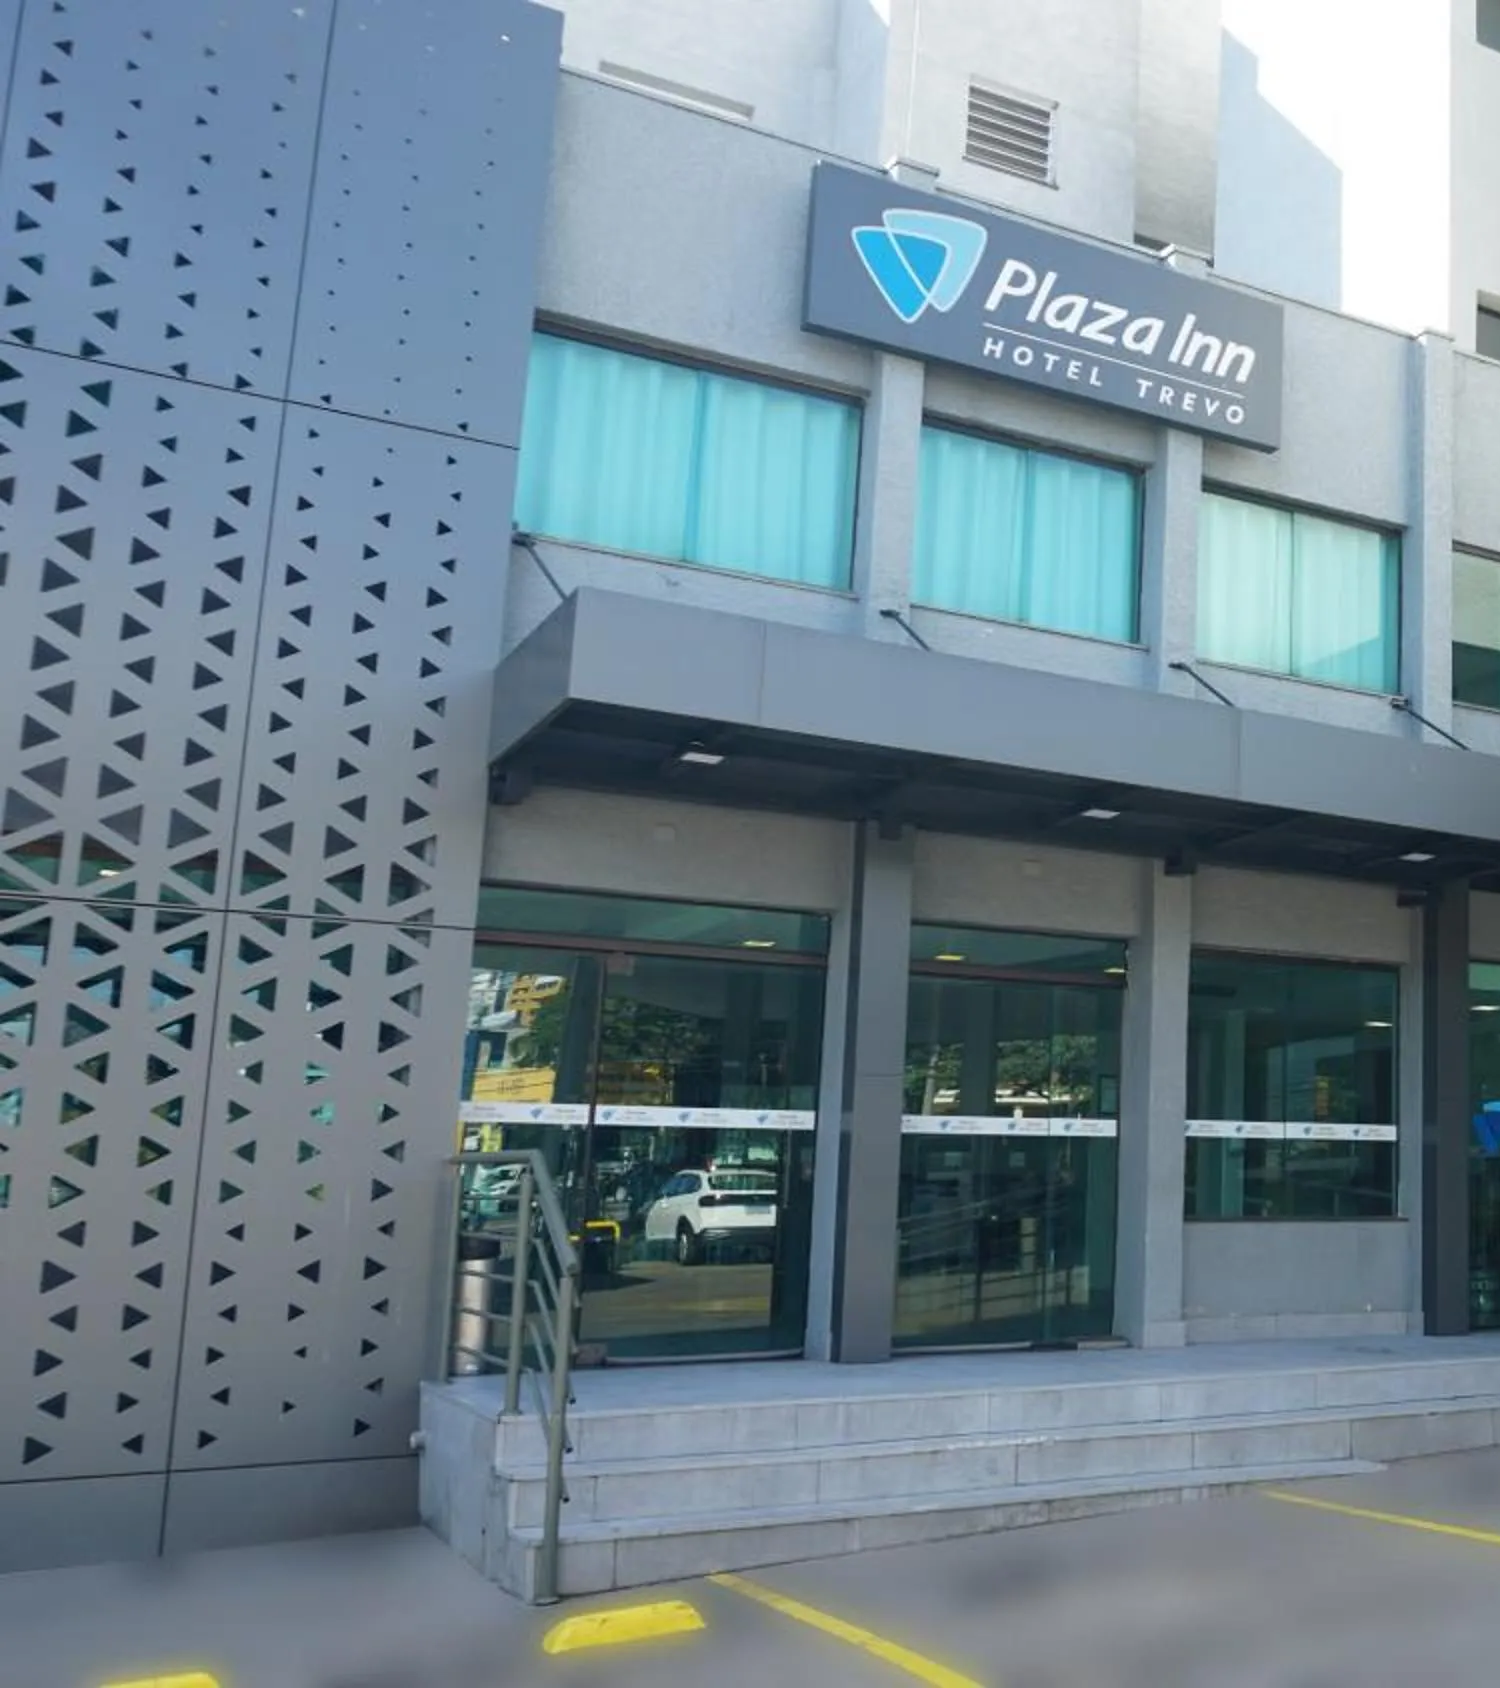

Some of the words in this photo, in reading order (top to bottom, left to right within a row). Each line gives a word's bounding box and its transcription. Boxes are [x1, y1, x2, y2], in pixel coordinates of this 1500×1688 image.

[984, 259, 1165, 355] Plaza
[1168, 313, 1256, 383] Inn
[983, 337, 1102, 387] HOTEL
[1136, 379, 1246, 425] TREVO
